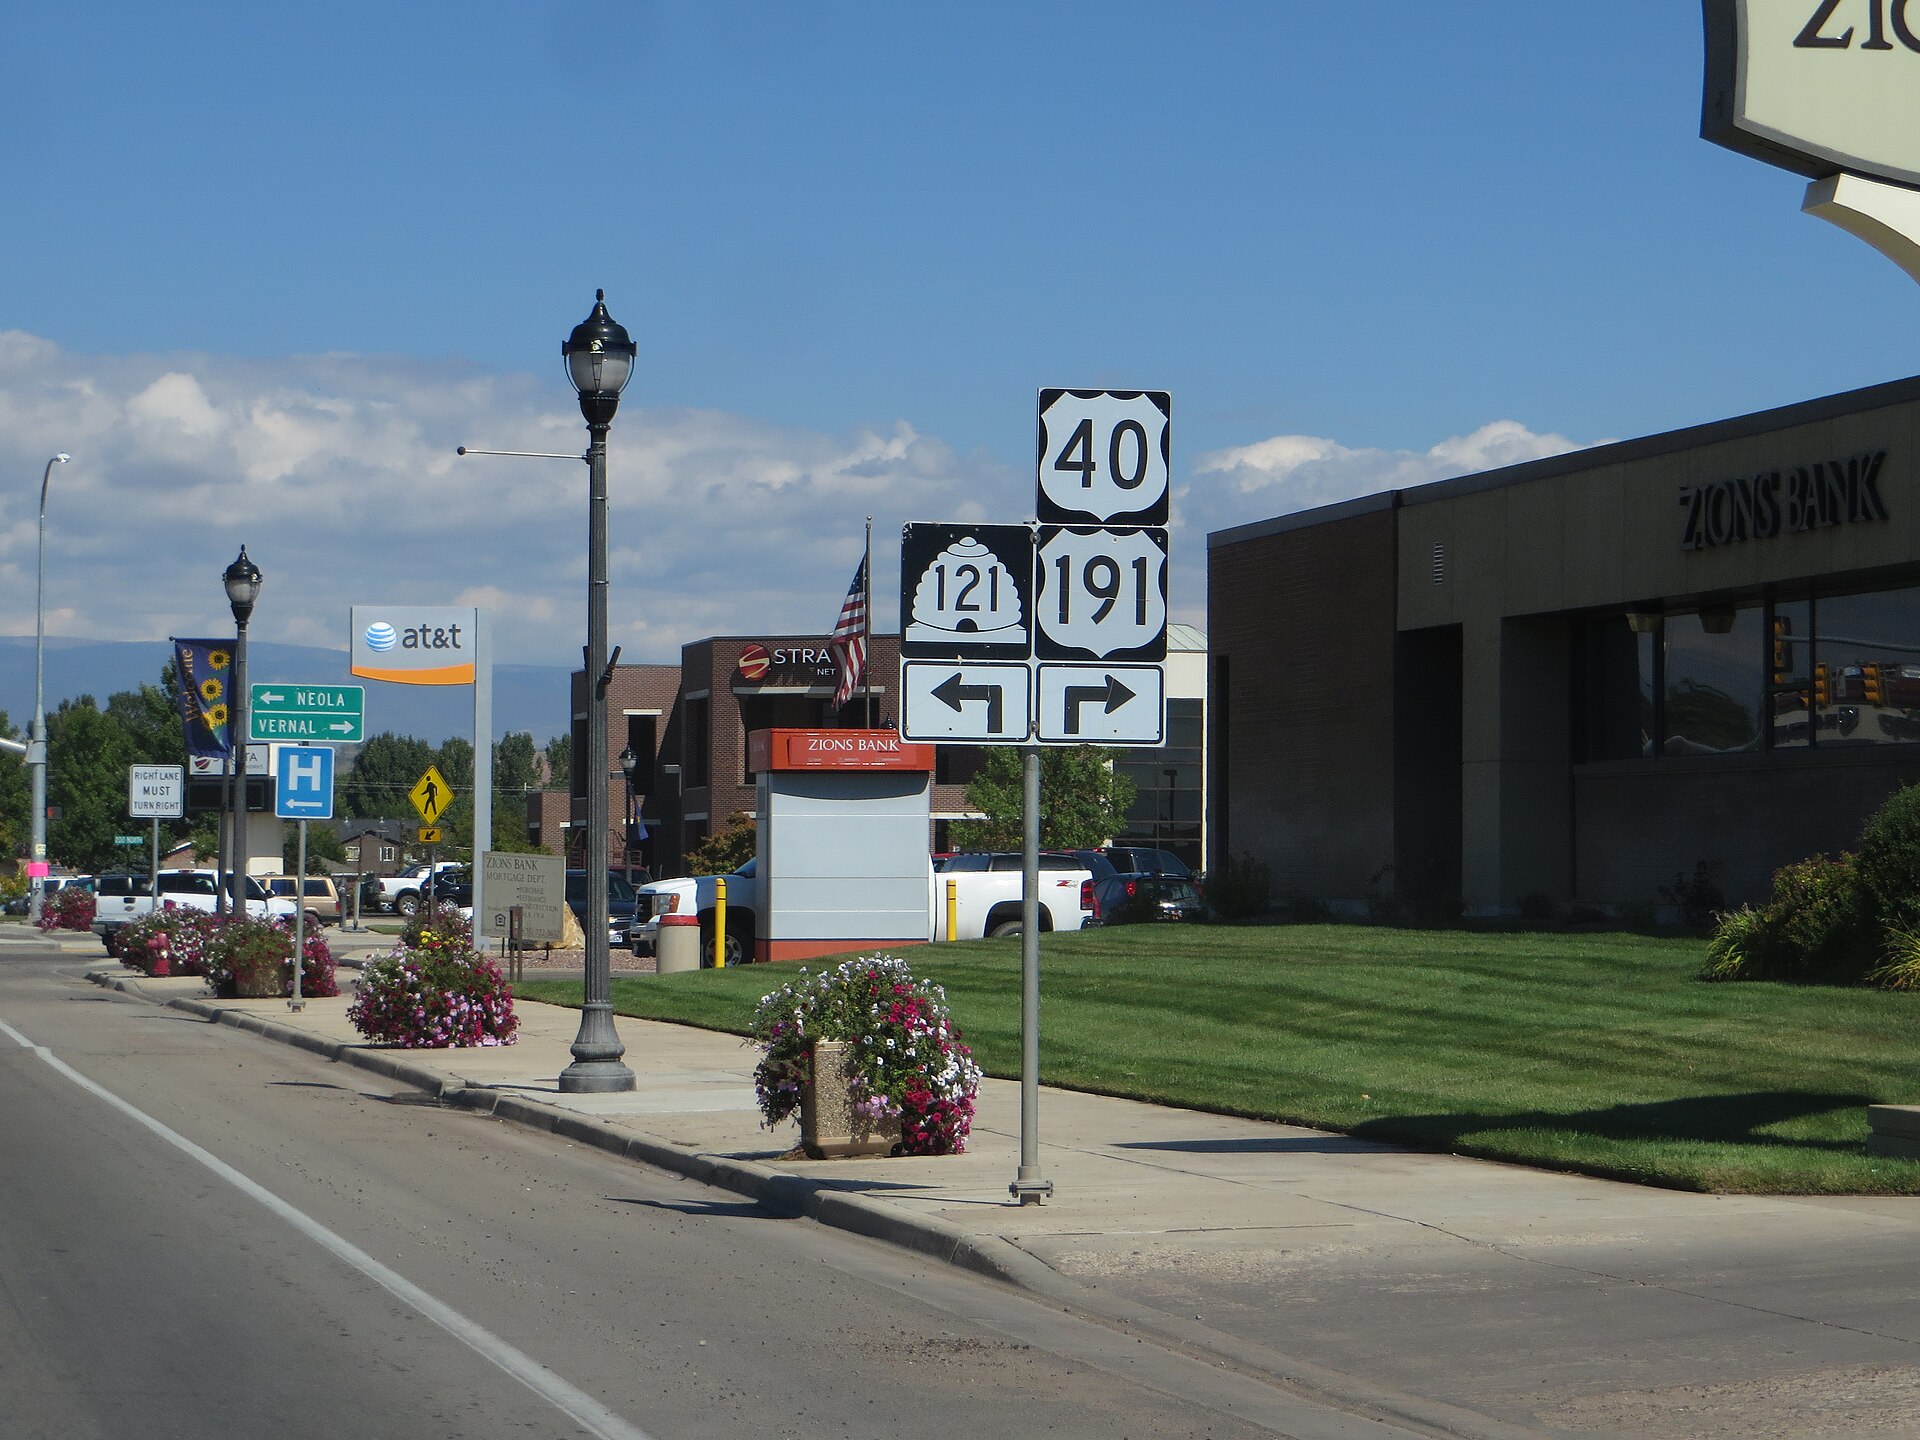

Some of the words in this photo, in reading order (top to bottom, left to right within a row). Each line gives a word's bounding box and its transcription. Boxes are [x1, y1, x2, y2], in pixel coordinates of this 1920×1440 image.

[1054, 419, 1148, 490] 40
[1679, 471, 1780, 550] ZIONS
[1782, 450, 1889, 535] BANK
[935, 564, 998, 612] 121
[1055, 555, 1147, 625] 191
[402, 623, 462, 650] at&t
[774, 648, 832, 664] STRA
[817, 668, 836, 676] NET
[297, 692, 345, 707] NEOLA
[259, 719, 316, 734] VERNAL
[808, 739, 854, 751] ZIONS
[858, 739, 900, 751] BANK
[134, 771, 158, 780] RIGHT
[159, 772, 180, 781] LANE
[288, 755, 322, 791] H
[143, 785, 171, 796] MUST
[134, 801, 155, 810] TURN
[155, 801, 179, 810] RIGHT
[486, 857, 512, 869] ZIONS
[514, 858, 538, 871] BANK
[486, 872, 525, 882] MORTGAGE
[527, 874, 548, 884] DEPT.
